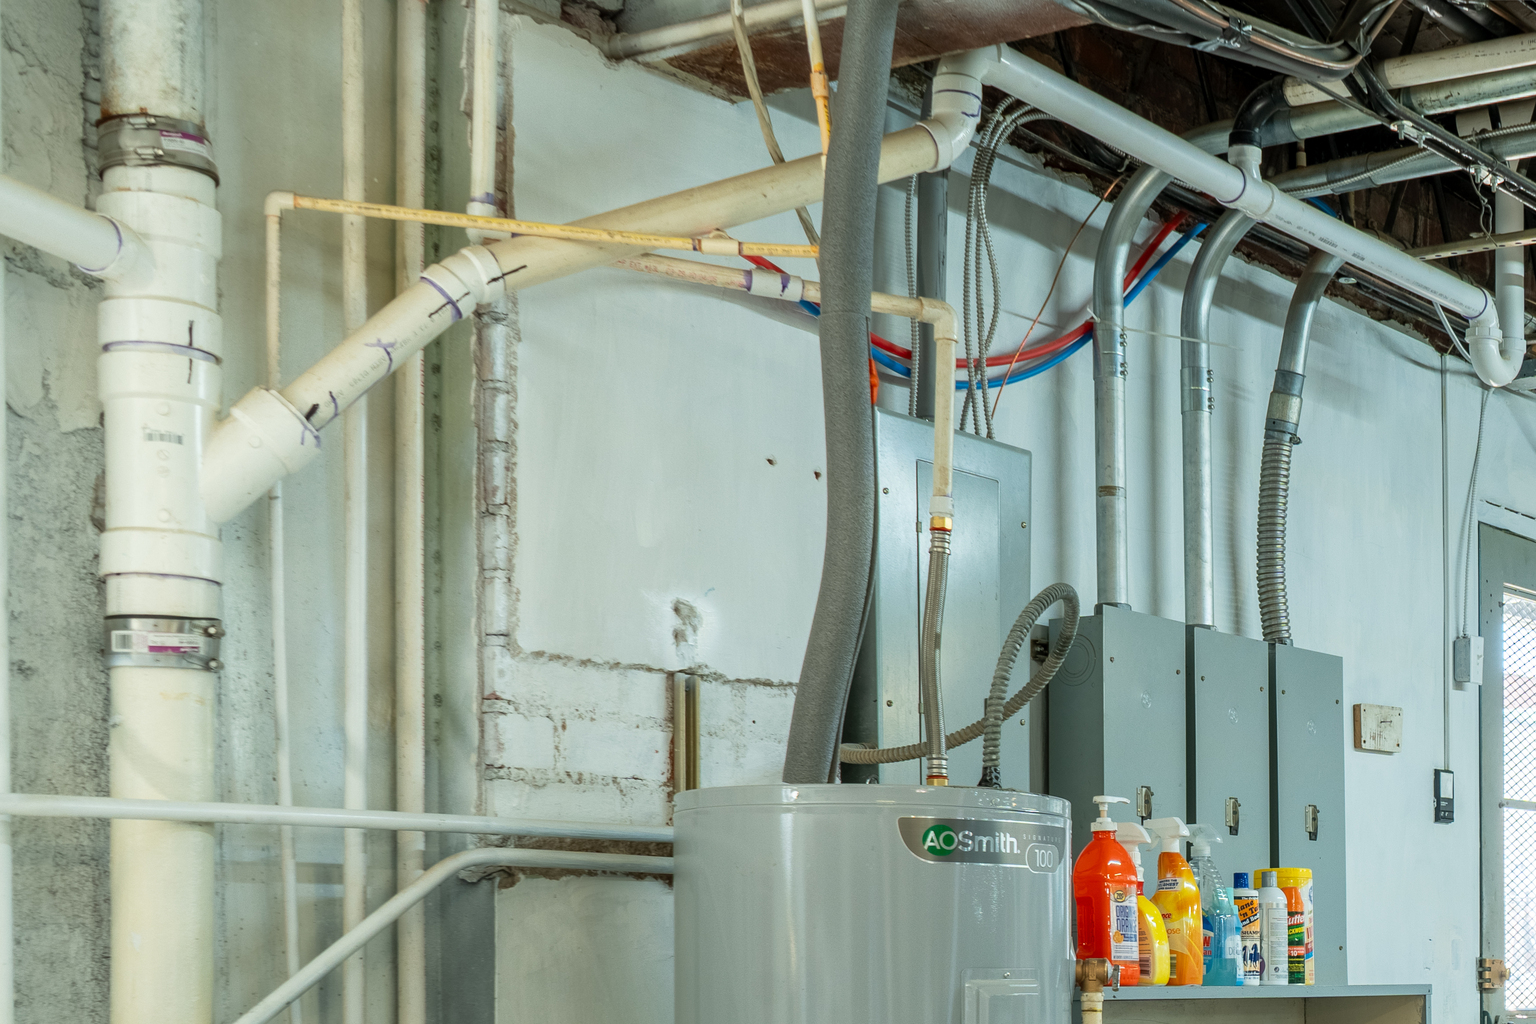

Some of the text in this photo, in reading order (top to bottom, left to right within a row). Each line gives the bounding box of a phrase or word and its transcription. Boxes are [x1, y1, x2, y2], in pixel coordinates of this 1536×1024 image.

[1023, 834, 1061, 843] SIGNATURE
[1034, 849, 1053, 868] 100
[1239, 900, 1254, 912] ane
